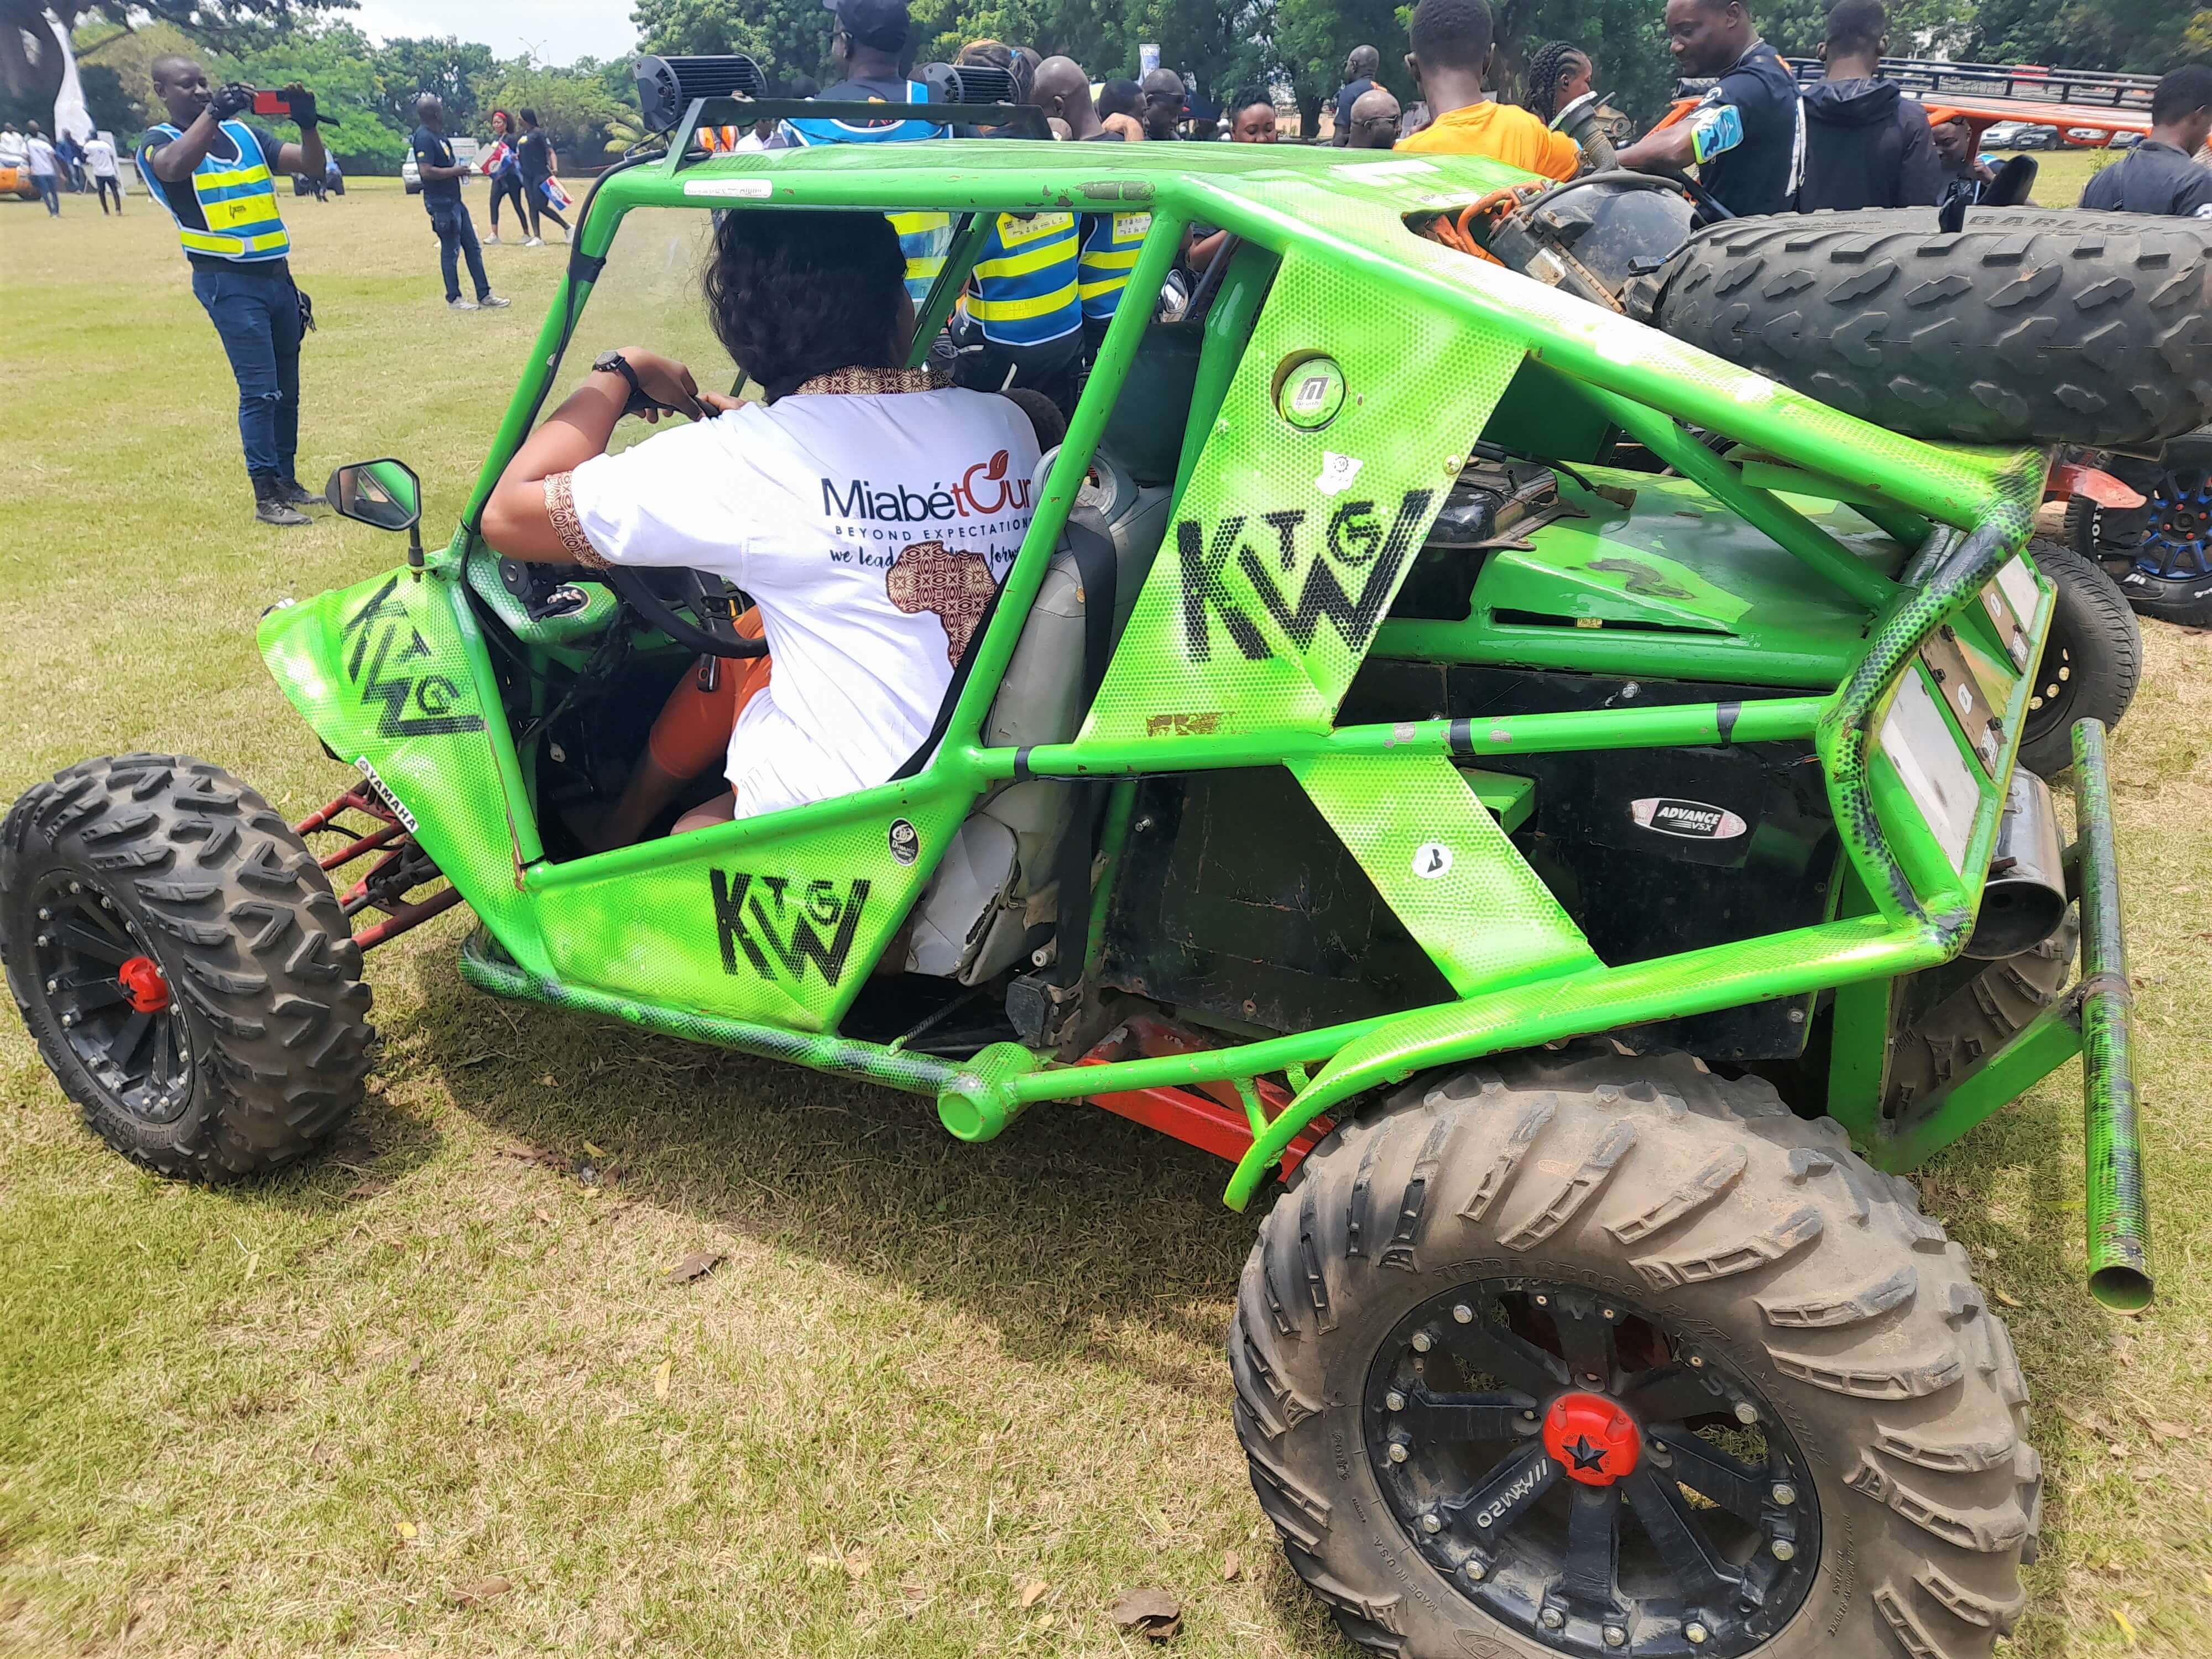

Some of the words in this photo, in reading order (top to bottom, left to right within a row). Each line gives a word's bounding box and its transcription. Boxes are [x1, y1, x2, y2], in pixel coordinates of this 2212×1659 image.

[835, 525, 911, 541] BEYOND
[830, 549, 853, 562] we
[859, 546, 895, 568] lead
[368, 771, 417, 831] YAMAHA
[1657, 806, 1721, 825] ADVANCE
[1691, 822, 1714, 832] VSX
[1374, 1534, 1397, 1568] U.S.A.
[1395, 1568, 1408, 1580] IN
[1408, 1583, 1438, 1613] MADE
[1828, 1600, 1848, 1637] SERVICE
